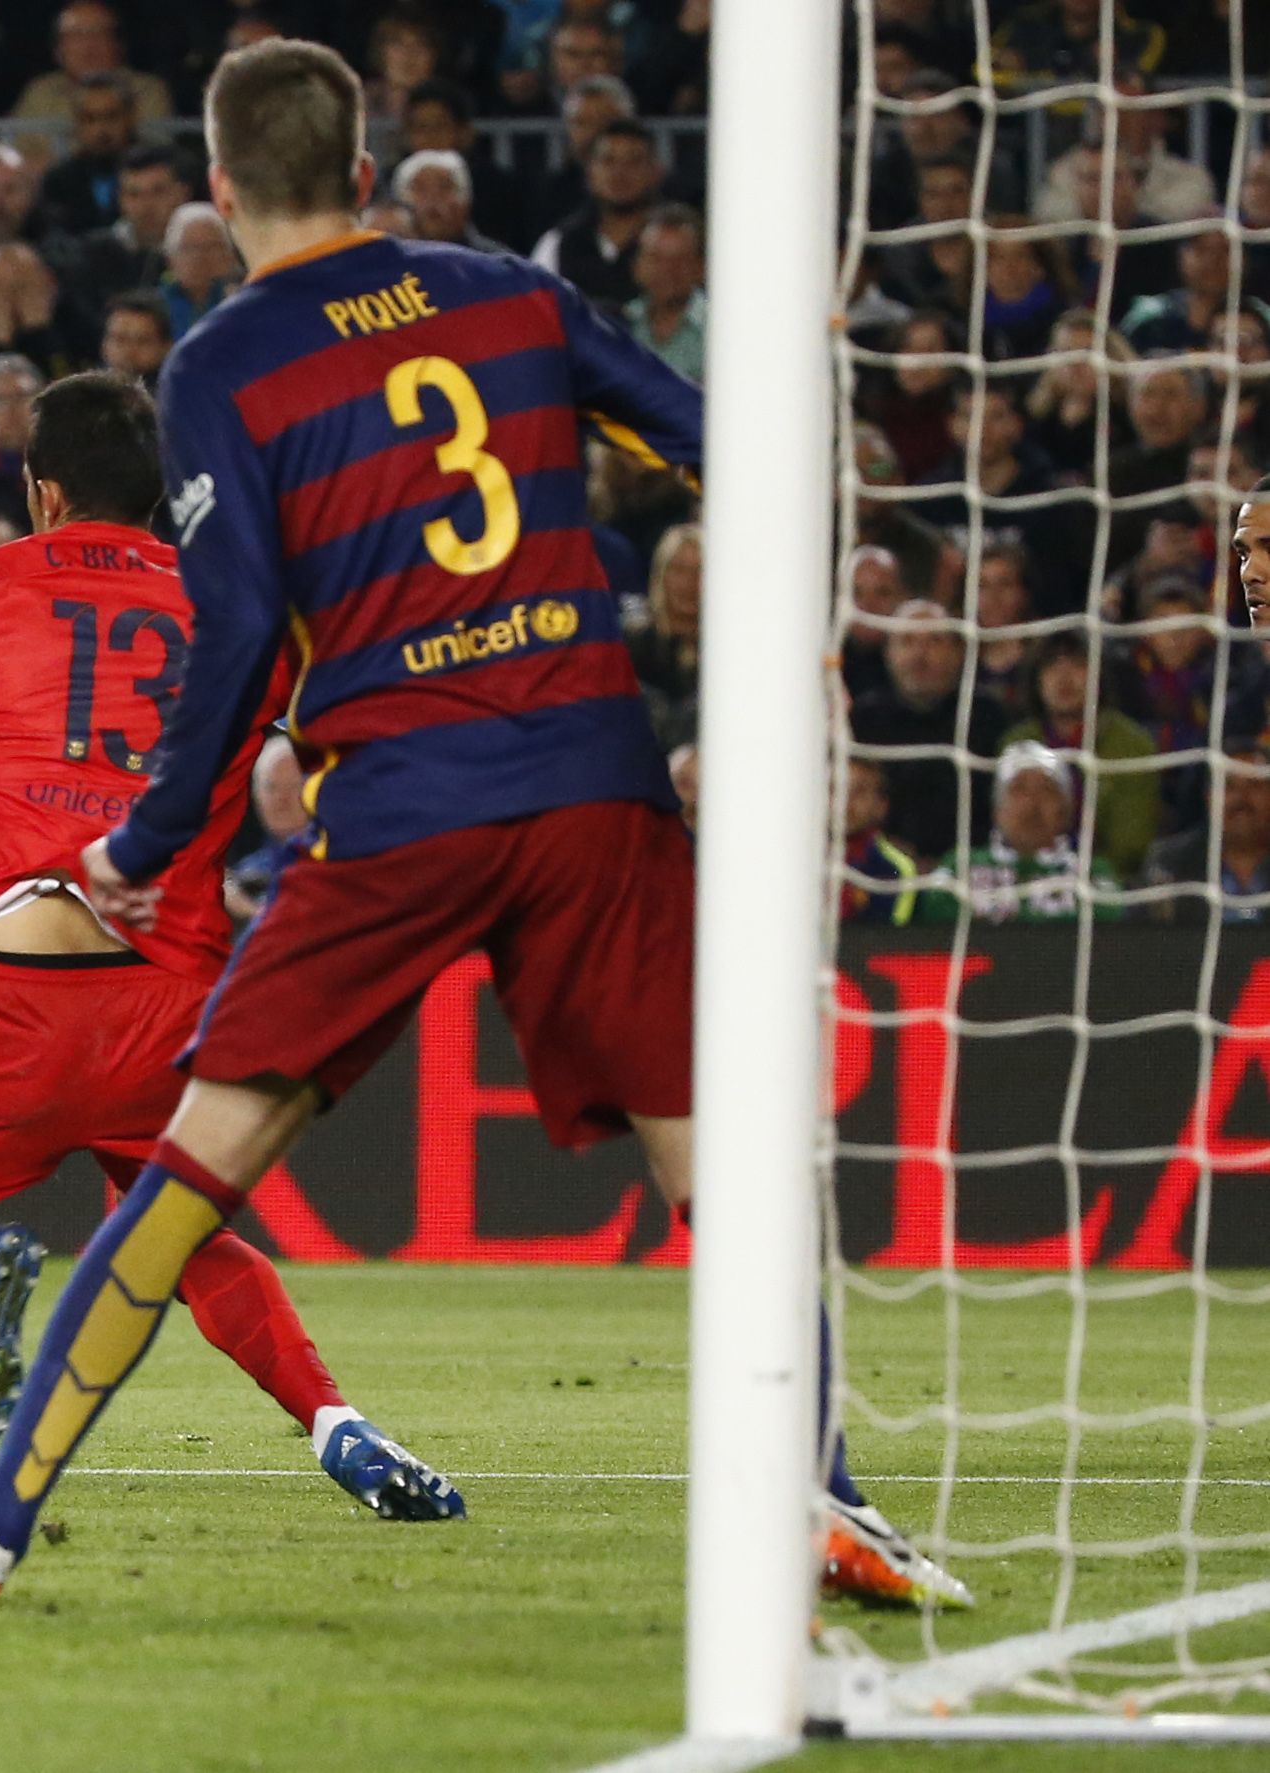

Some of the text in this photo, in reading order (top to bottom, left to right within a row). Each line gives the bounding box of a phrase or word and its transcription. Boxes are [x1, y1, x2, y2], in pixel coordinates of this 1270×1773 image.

[323, 271, 439, 338] PIQUÉ
[385, 355, 520, 575] 3
[52, 599, 191, 776] 13
[402, 603, 528, 674] unicef
